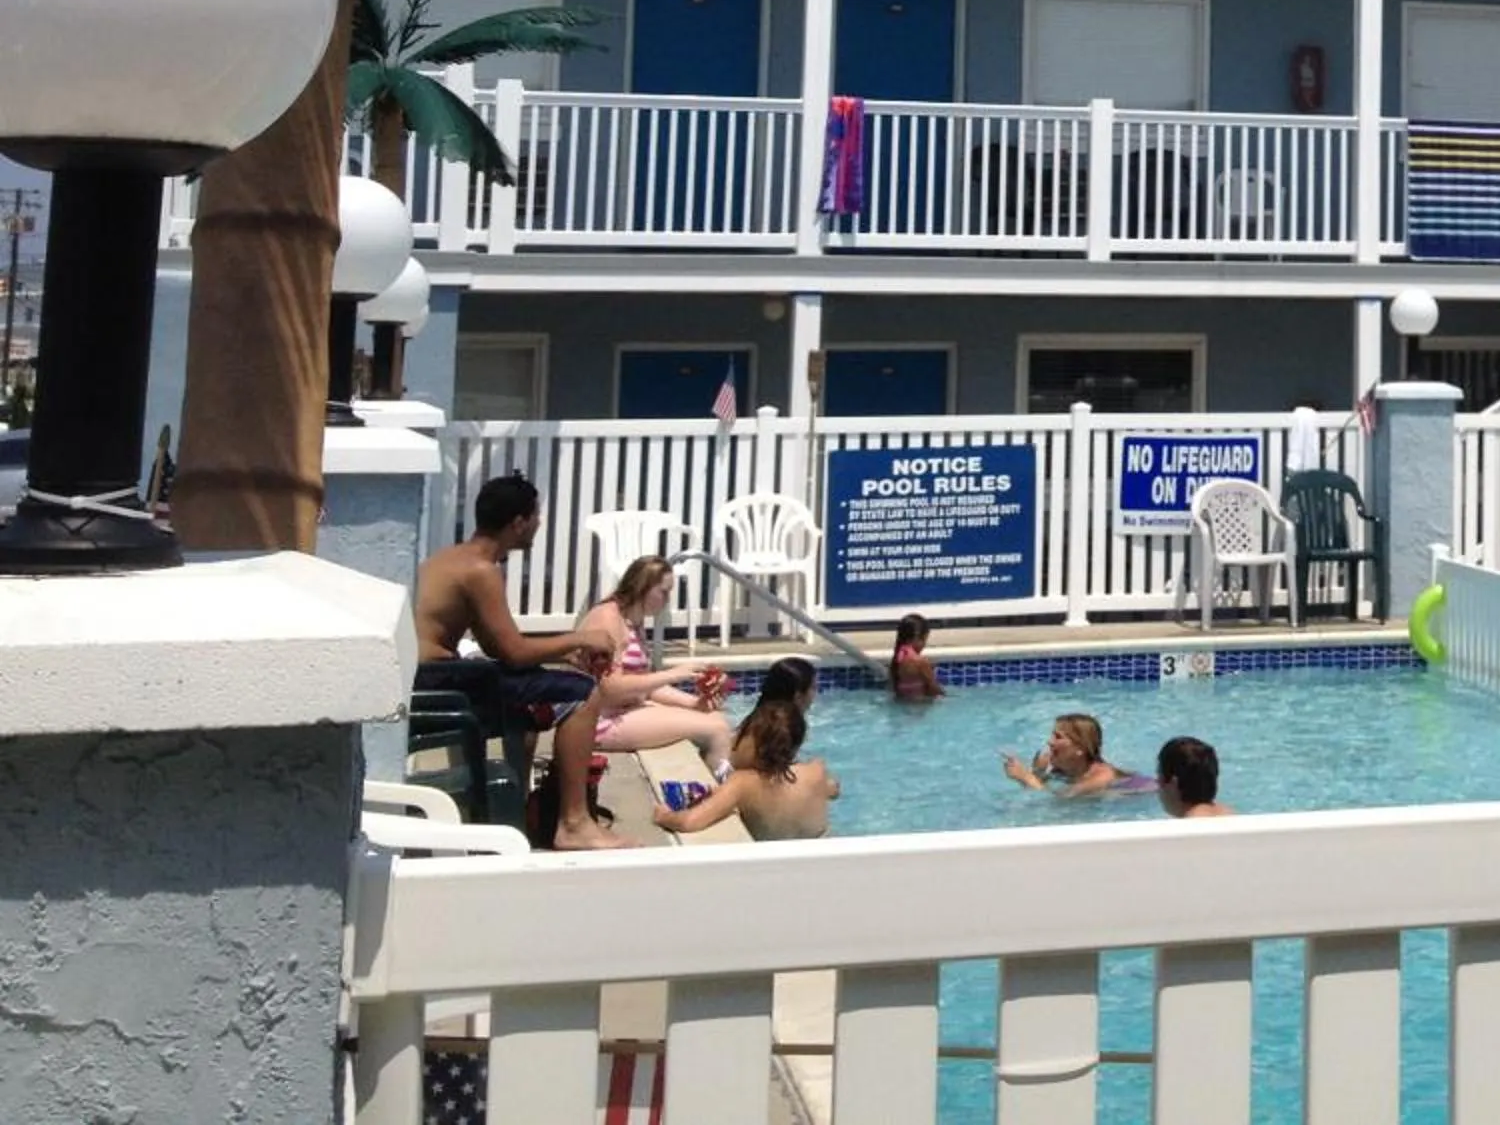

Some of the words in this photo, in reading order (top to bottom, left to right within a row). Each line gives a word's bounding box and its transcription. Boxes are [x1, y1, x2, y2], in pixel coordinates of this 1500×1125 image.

[892, 456, 982, 475] NOTICE
[1127, 444, 1153, 473] NO
[1161, 445, 1254, 473] LIFEGUARD
[861, 478, 927, 496] POOL
[933, 475, 1012, 493] RULES
[1151, 476, 1177, 504] ON
[1163, 656, 1175, 676] 3
